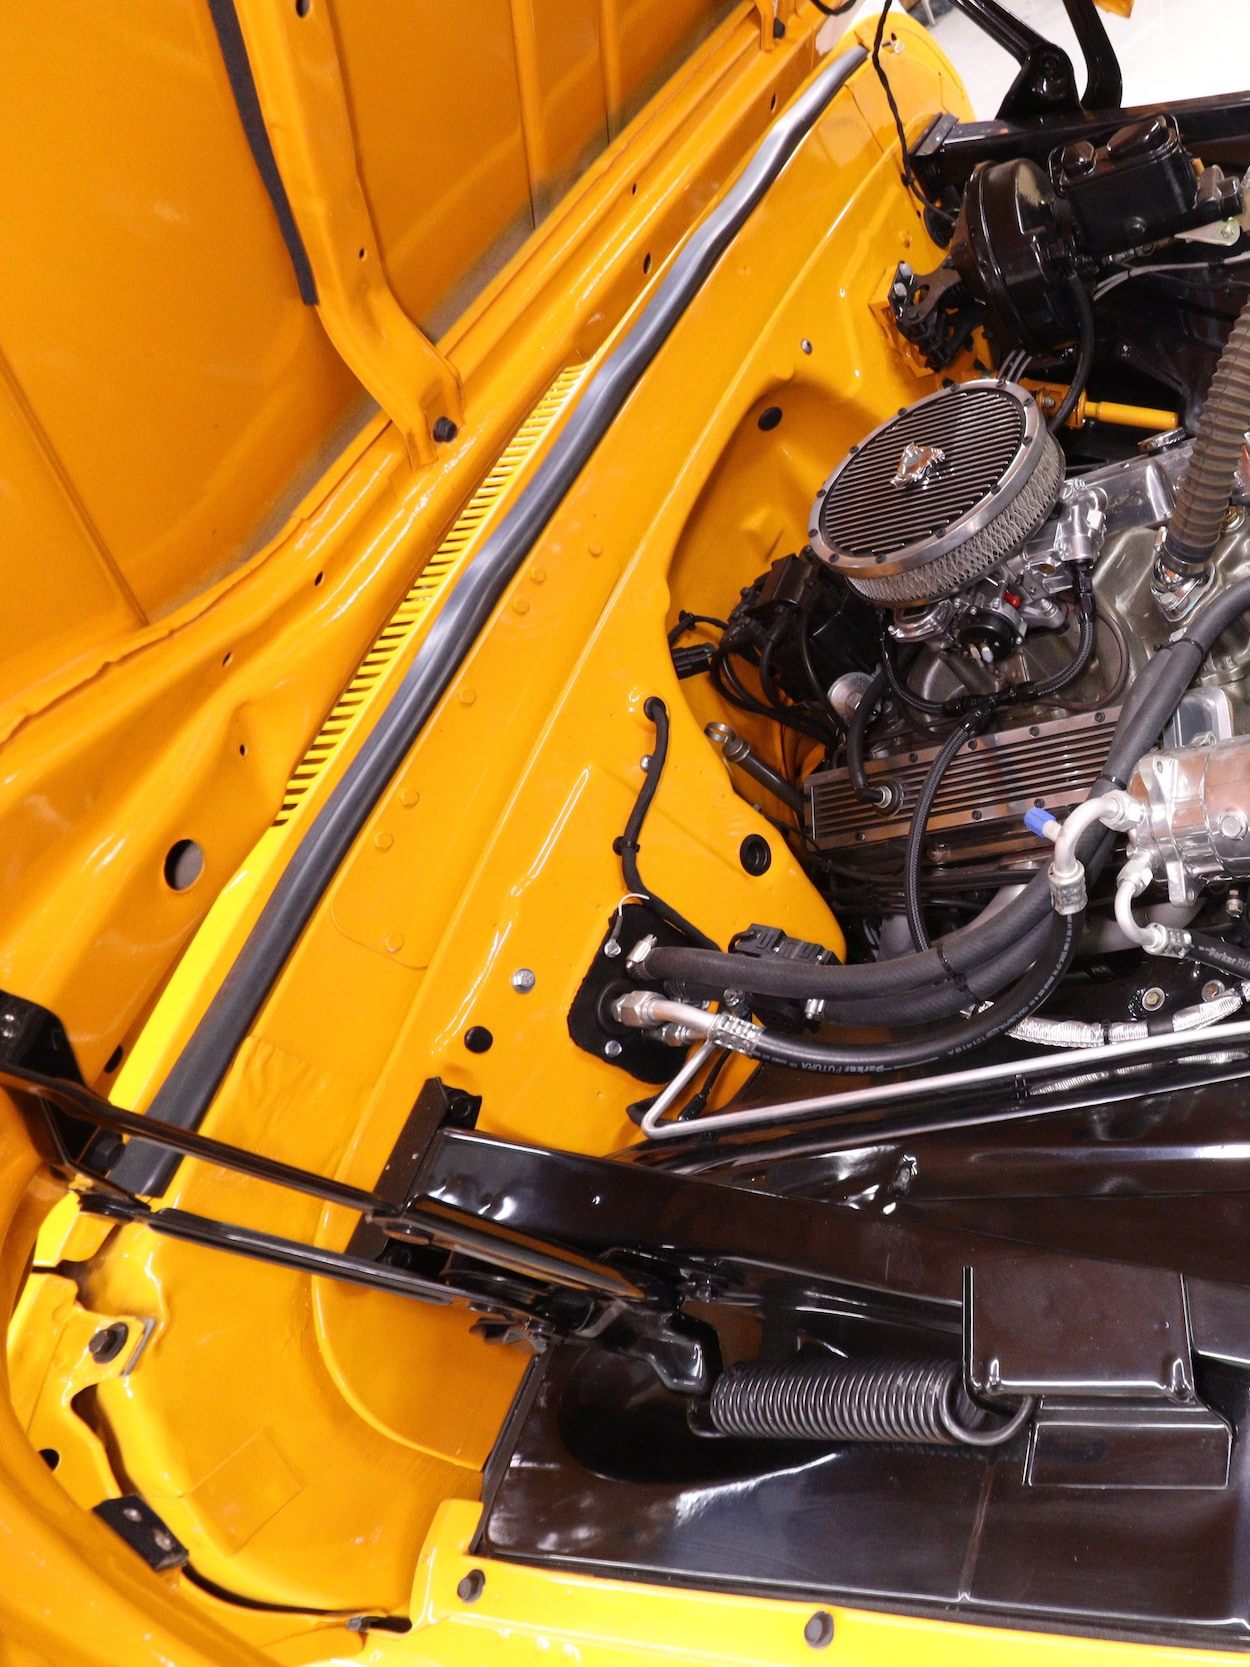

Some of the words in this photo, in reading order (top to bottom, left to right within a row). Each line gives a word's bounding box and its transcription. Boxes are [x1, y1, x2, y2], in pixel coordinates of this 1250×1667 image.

[1208, 947, 1237, 964] Parker
[801, 1062, 842, 1072] FUTURA
[845, 1064, 885, 1073] Parker
